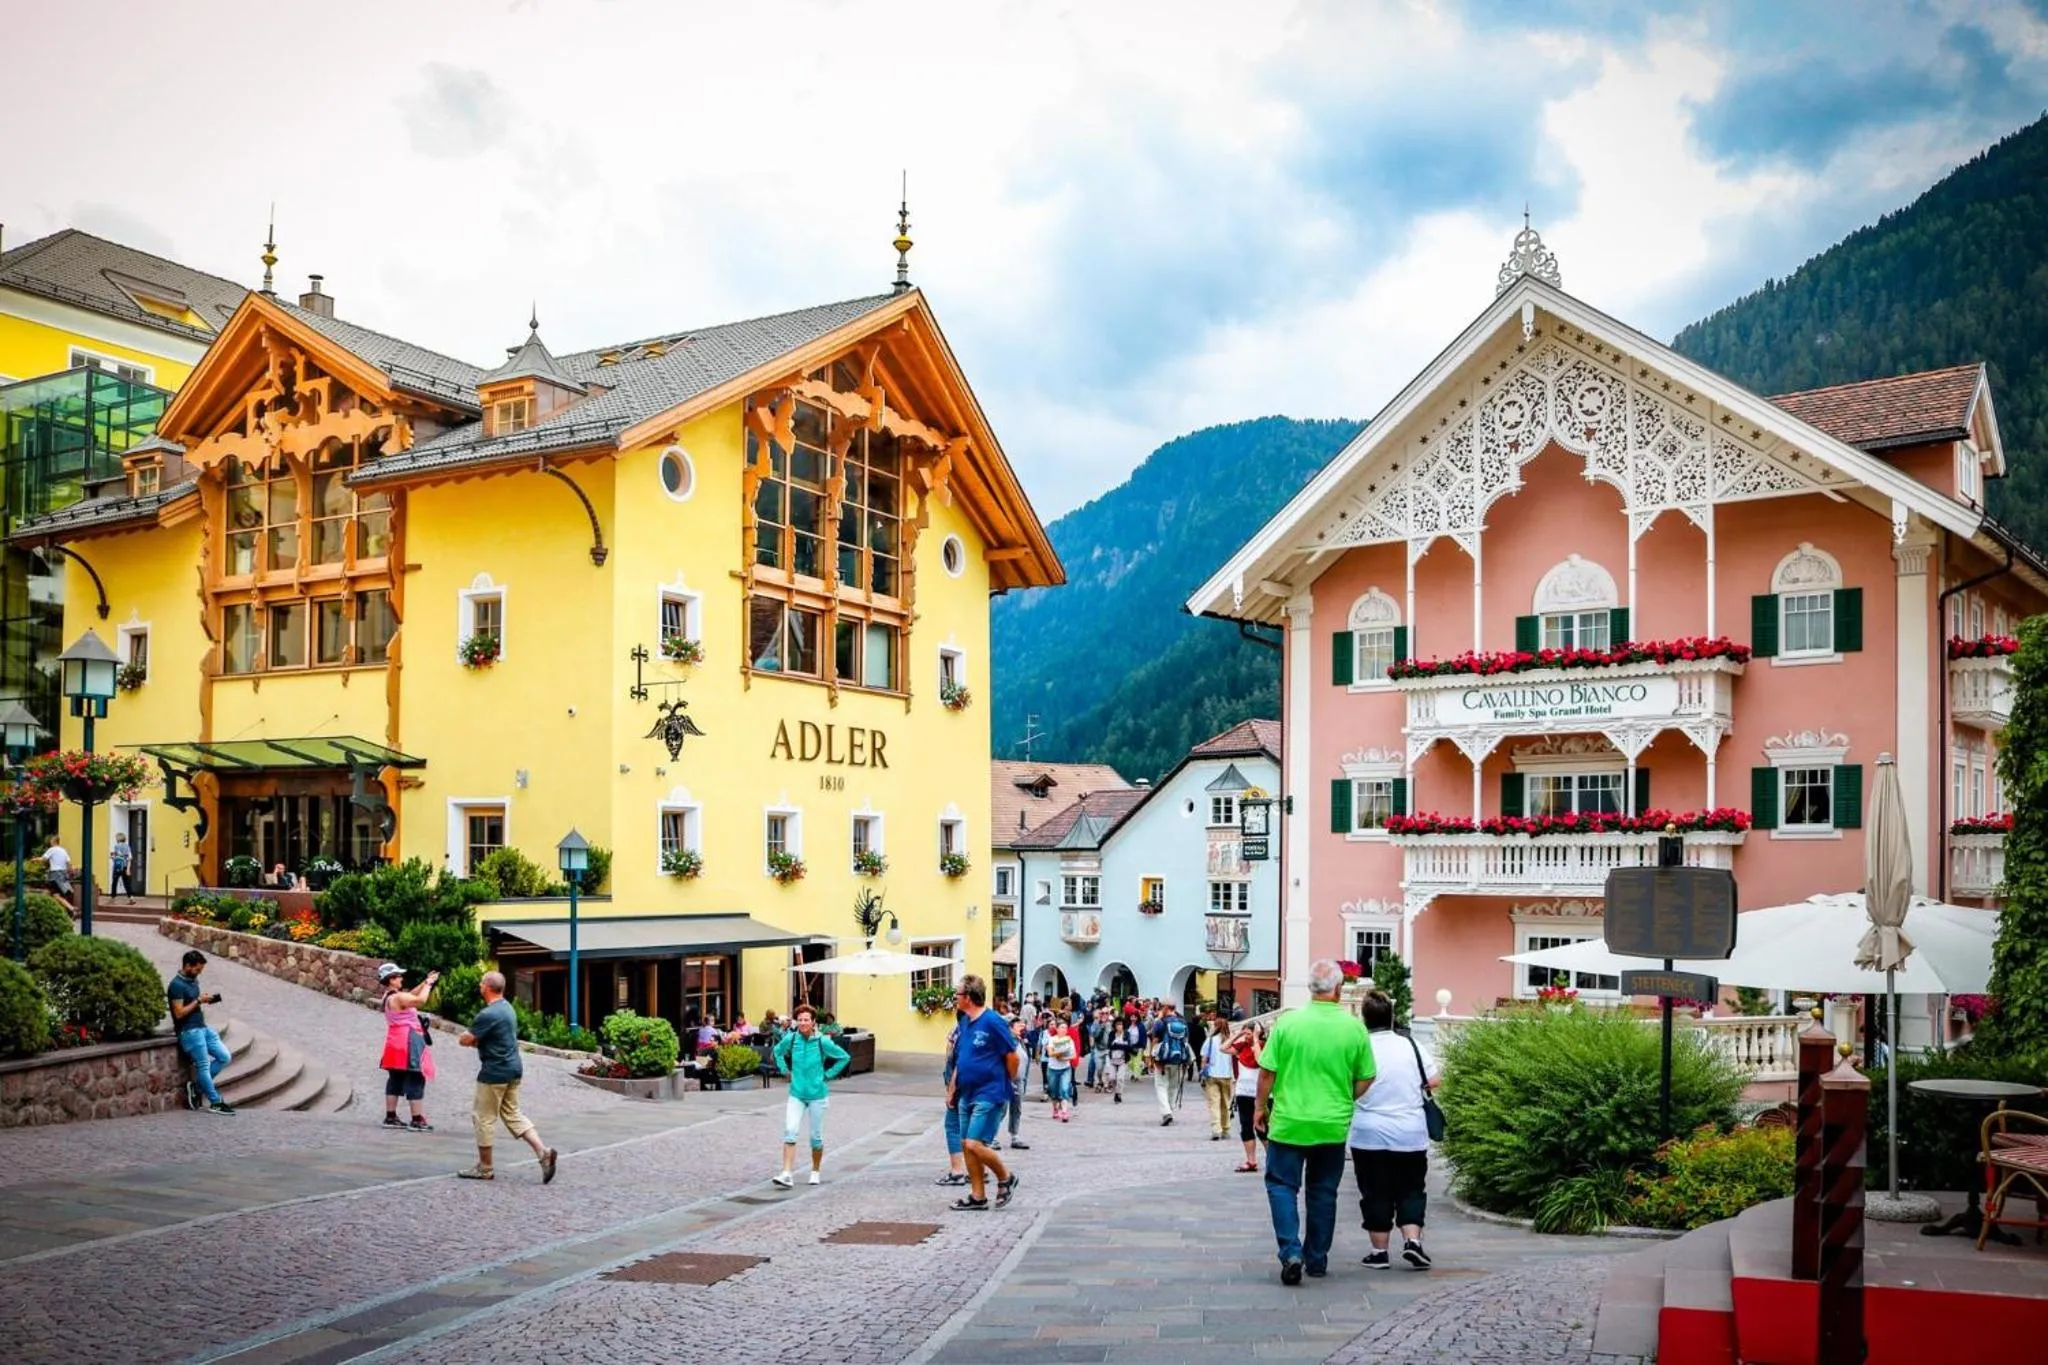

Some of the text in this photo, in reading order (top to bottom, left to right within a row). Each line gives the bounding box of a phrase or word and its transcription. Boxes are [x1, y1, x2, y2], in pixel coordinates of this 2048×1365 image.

[1494, 704, 1612, 720] Family Spa Grand Hotel
[770, 718, 889, 769] ADLER
[820, 775, 845, 791] 1810
